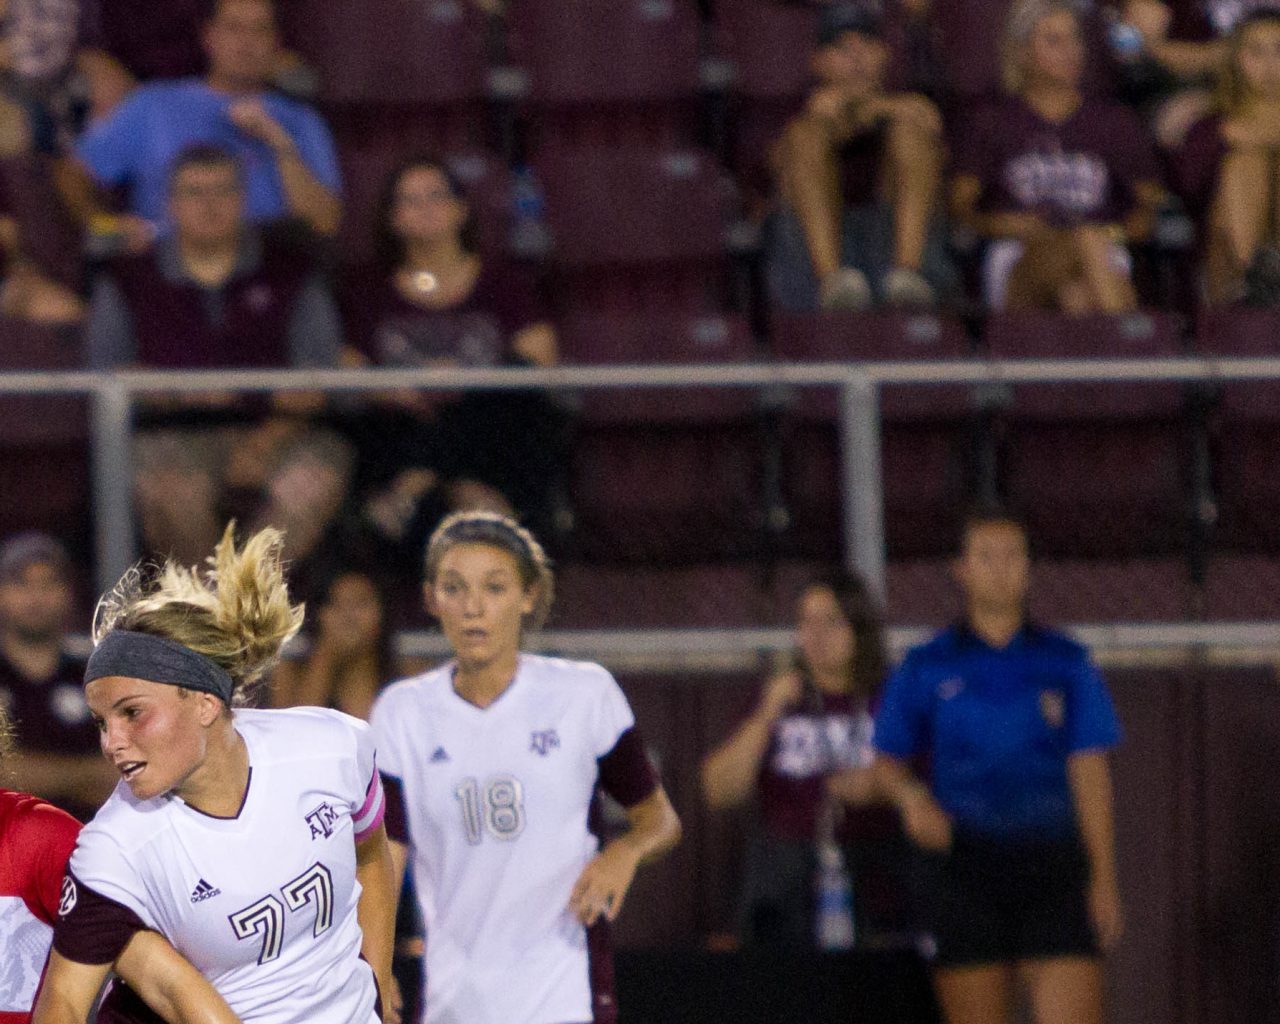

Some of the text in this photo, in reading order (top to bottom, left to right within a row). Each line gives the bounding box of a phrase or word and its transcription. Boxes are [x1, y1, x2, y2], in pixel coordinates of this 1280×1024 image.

[455, 776, 526, 846] 18
[191, 888, 221, 903] adidas
[228, 861, 334, 966] 77
